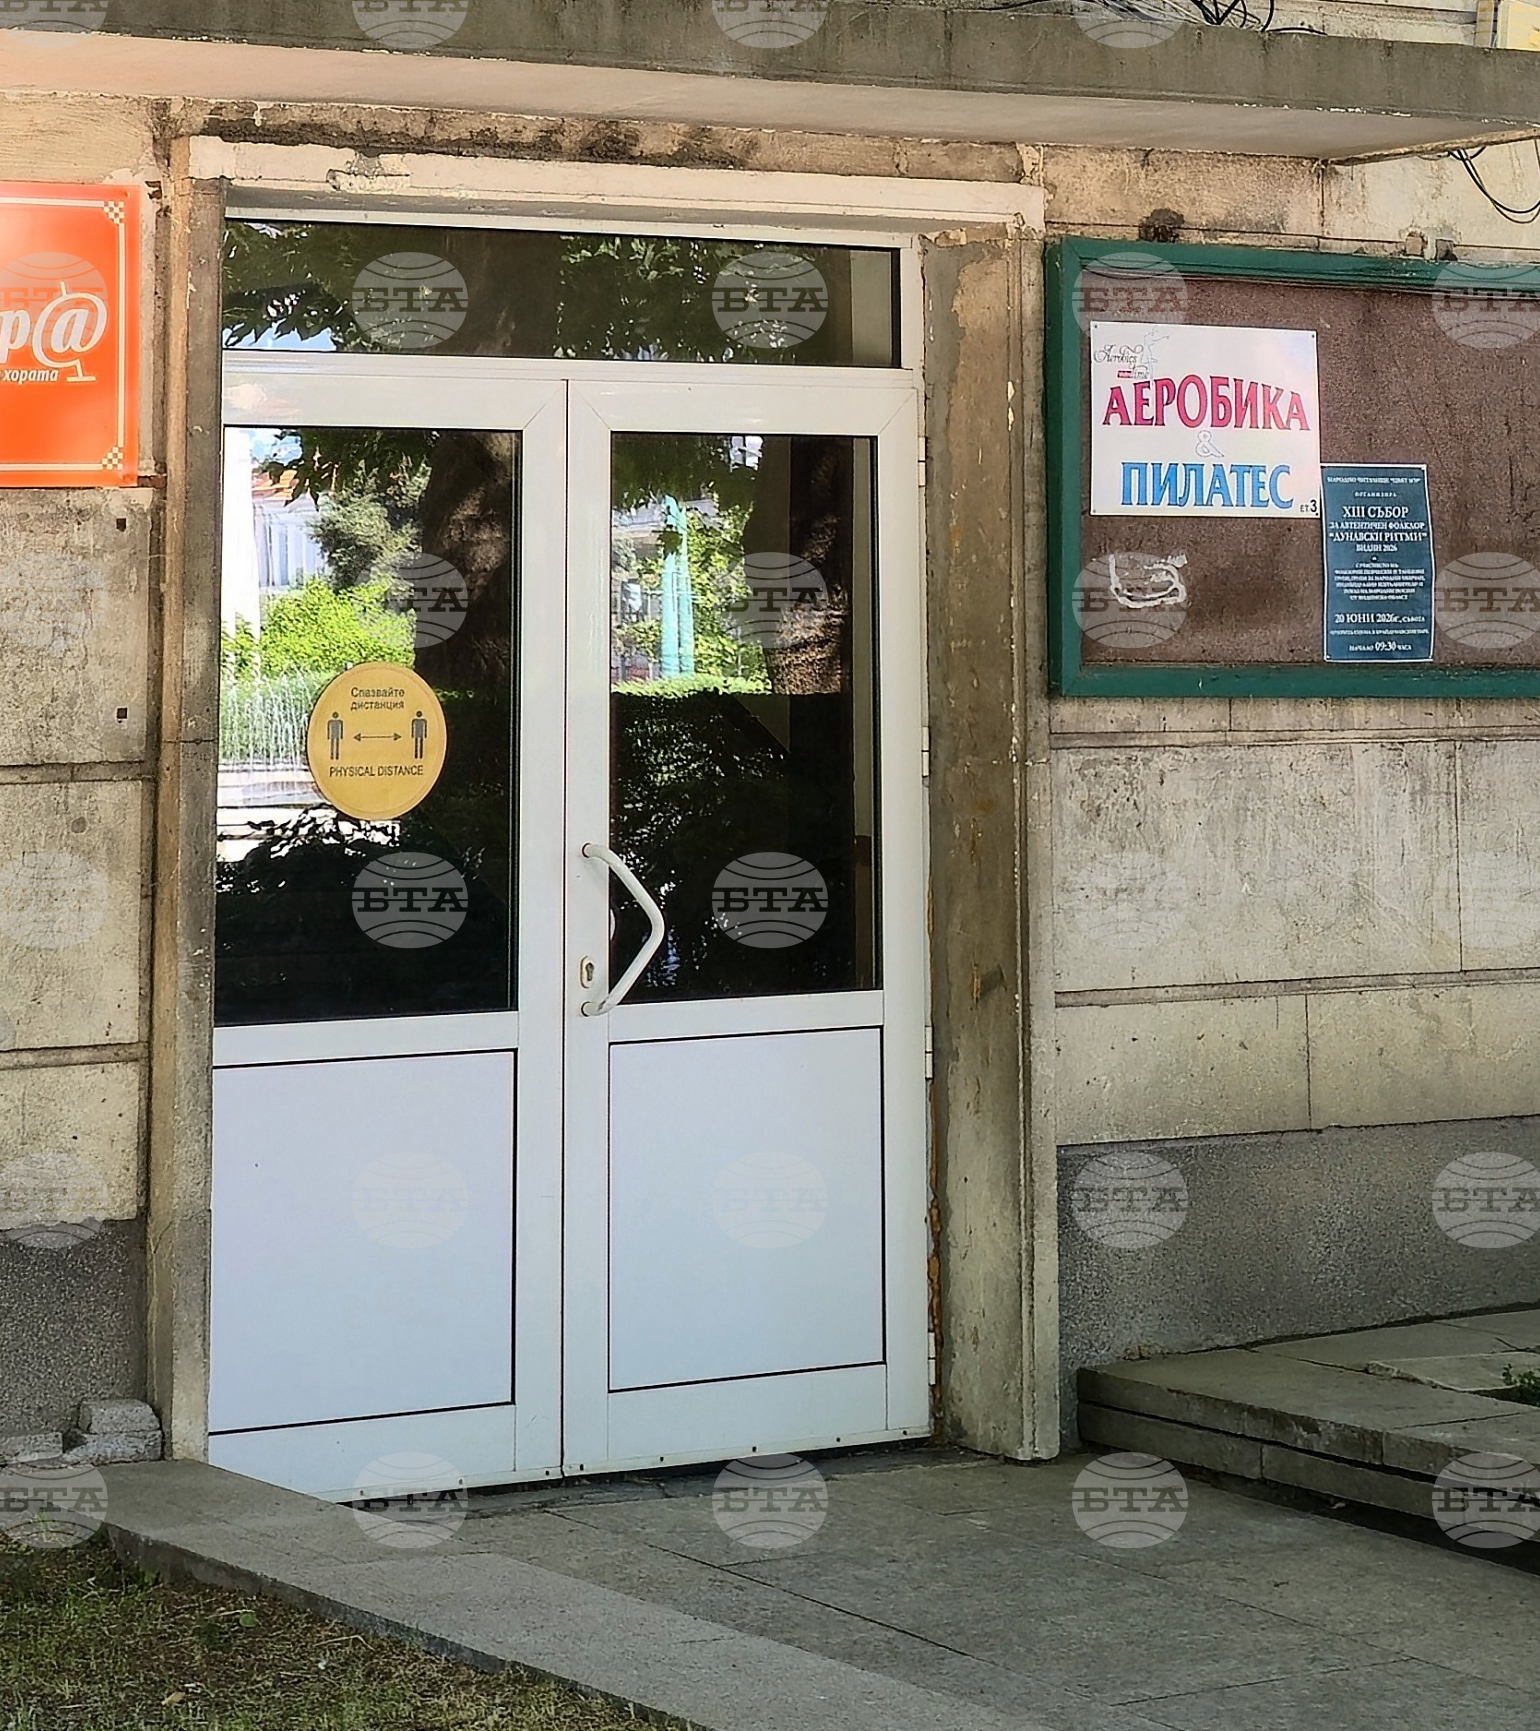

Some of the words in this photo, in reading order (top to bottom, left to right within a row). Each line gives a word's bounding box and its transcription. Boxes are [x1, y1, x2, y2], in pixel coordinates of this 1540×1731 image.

[3, 368, 59, 383] хората
[1101, 373, 1311, 431] АЕРОБИКА
[1195, 429, 1225, 458] &
[1120, 461, 1294, 510] ПИЛАТЕС
[1367, 505, 1409, 518] СЪБОР
[1334, 613, 1345, 623] 20
[1346, 613, 1375, 623] ЮНИ
[350, 700, 405, 711] дистанция
[329, 765, 376, 777] PHYSICAL
[377, 764, 424, 776] DISTANCE
